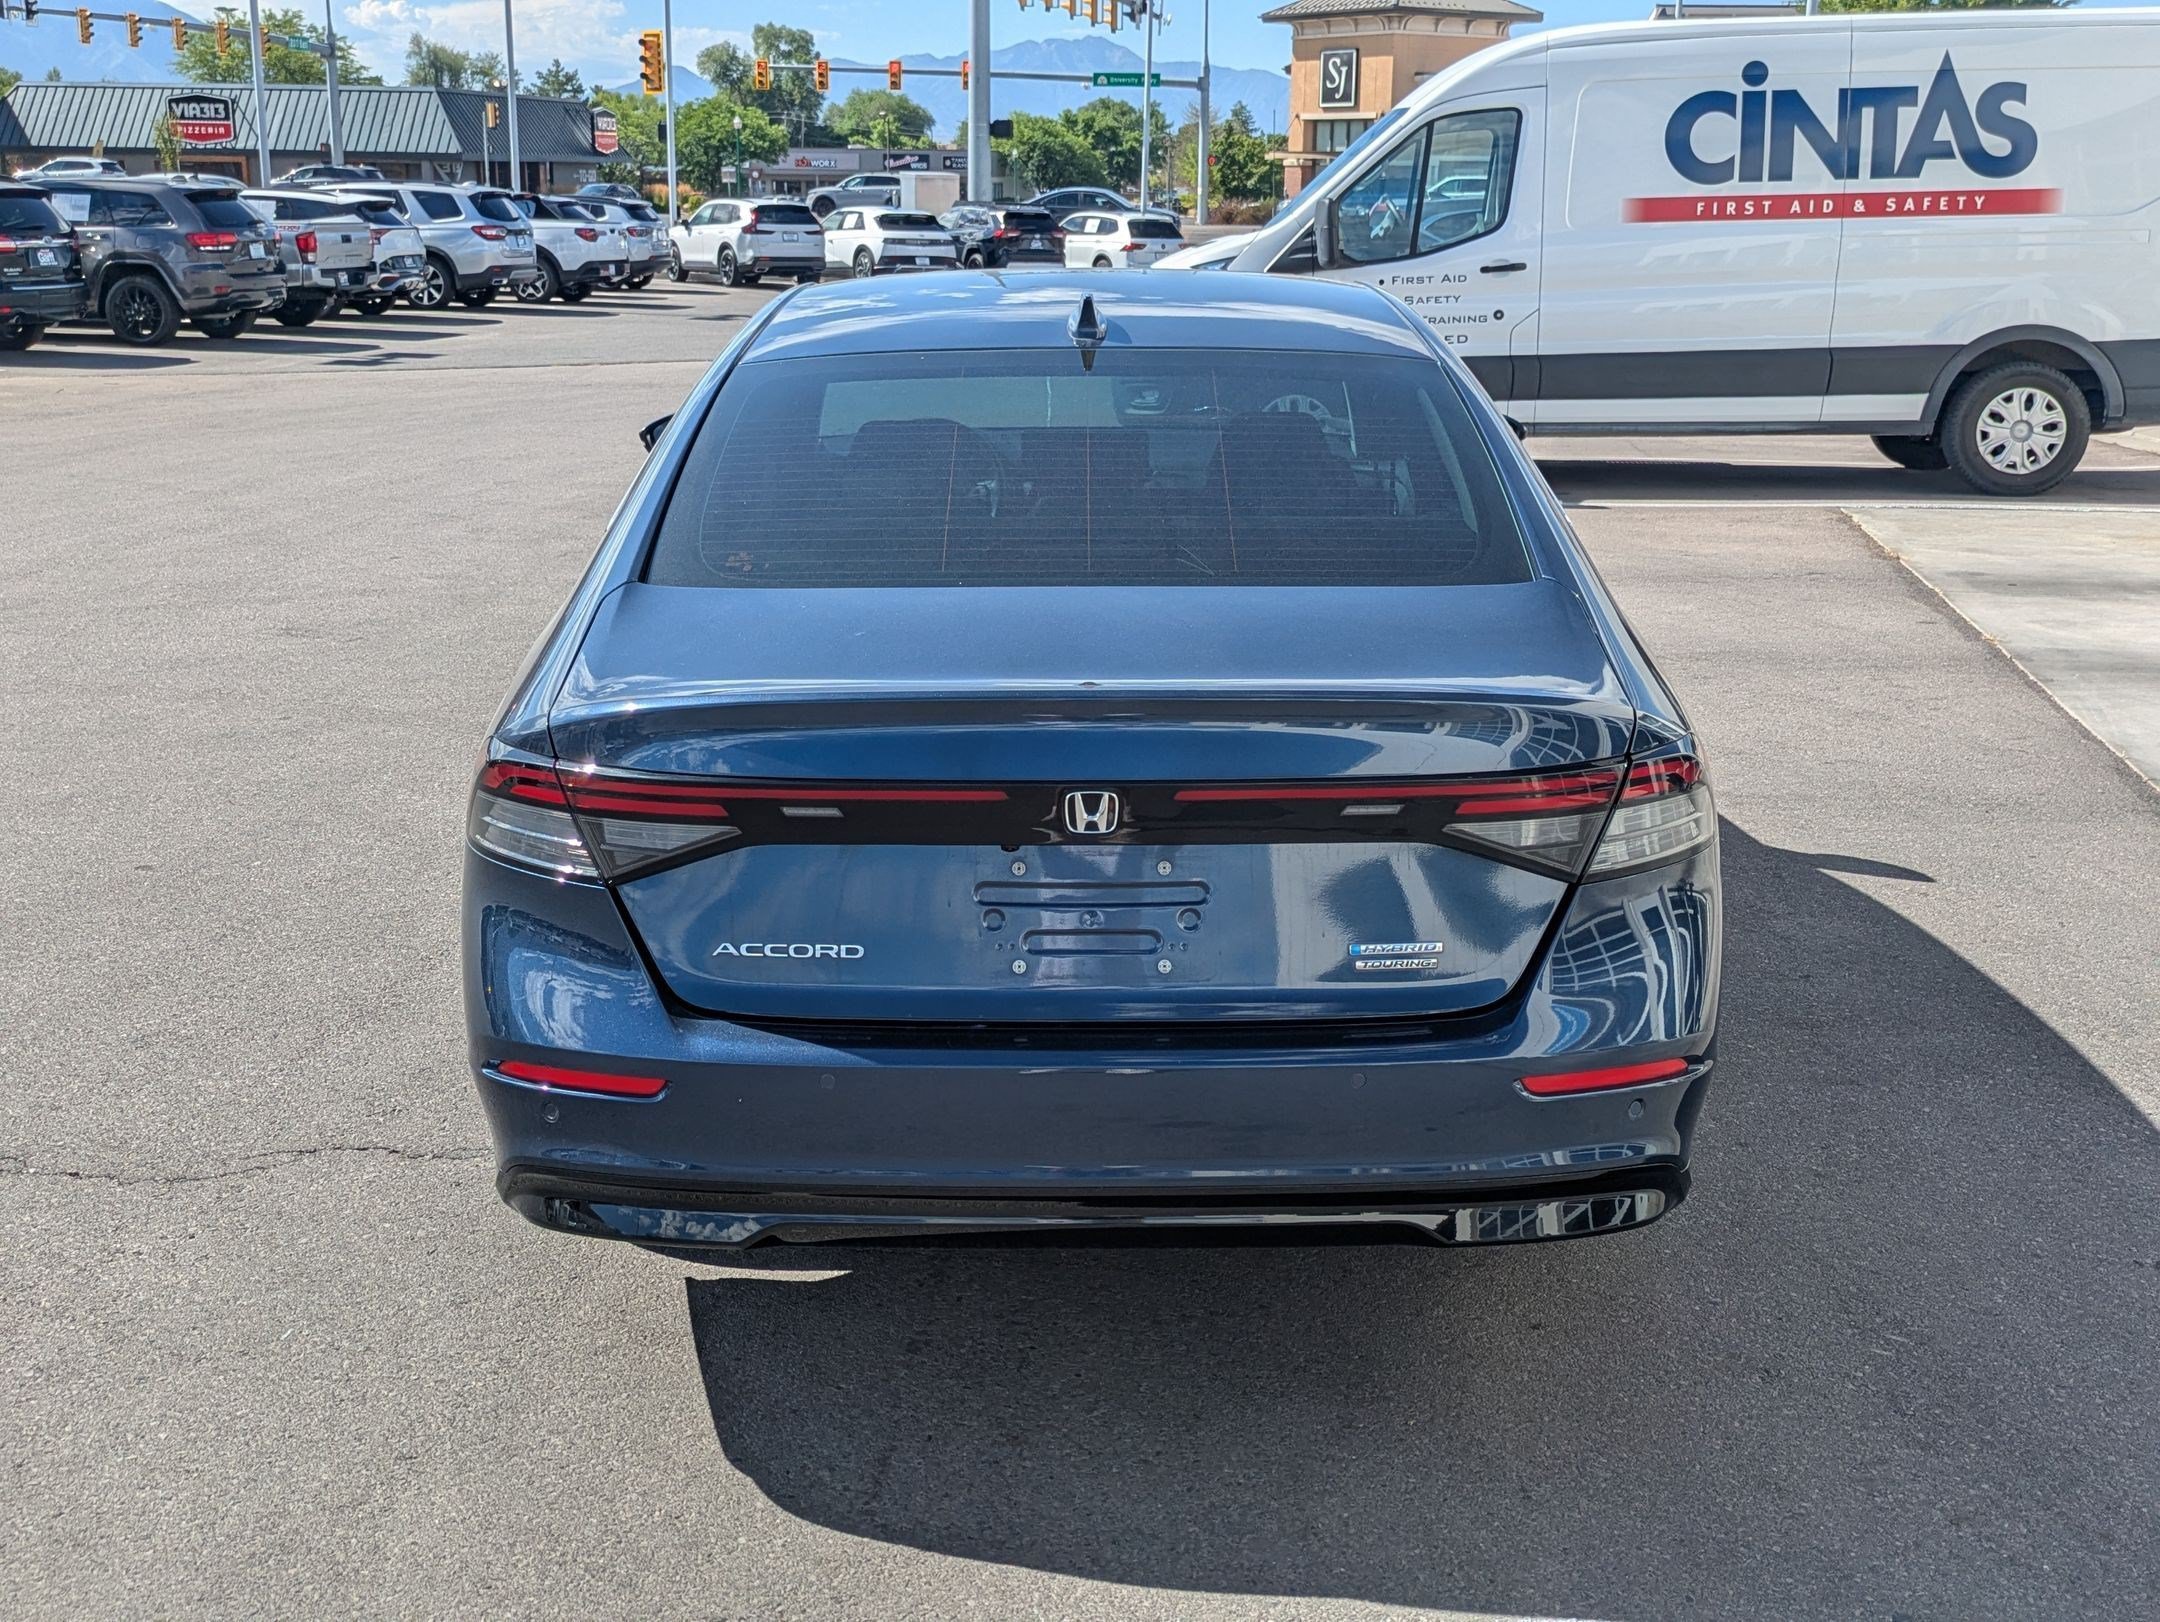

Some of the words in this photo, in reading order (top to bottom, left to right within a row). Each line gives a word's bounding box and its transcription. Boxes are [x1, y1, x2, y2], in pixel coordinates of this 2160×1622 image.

[177, 126, 225, 134] PIZZERIA
[1697, 201, 1772, 215] FIRST
[1790, 200, 1833, 214] AID
[1853, 199, 1866, 212] &
[1886, 195, 1986, 211] SAFETY
[1445, 334, 1468, 344] ED
[712, 942, 865, 959] ACCORD
[1360, 943, 1440, 954] HYBRID
[1360, 959, 1434, 969] TOURING
